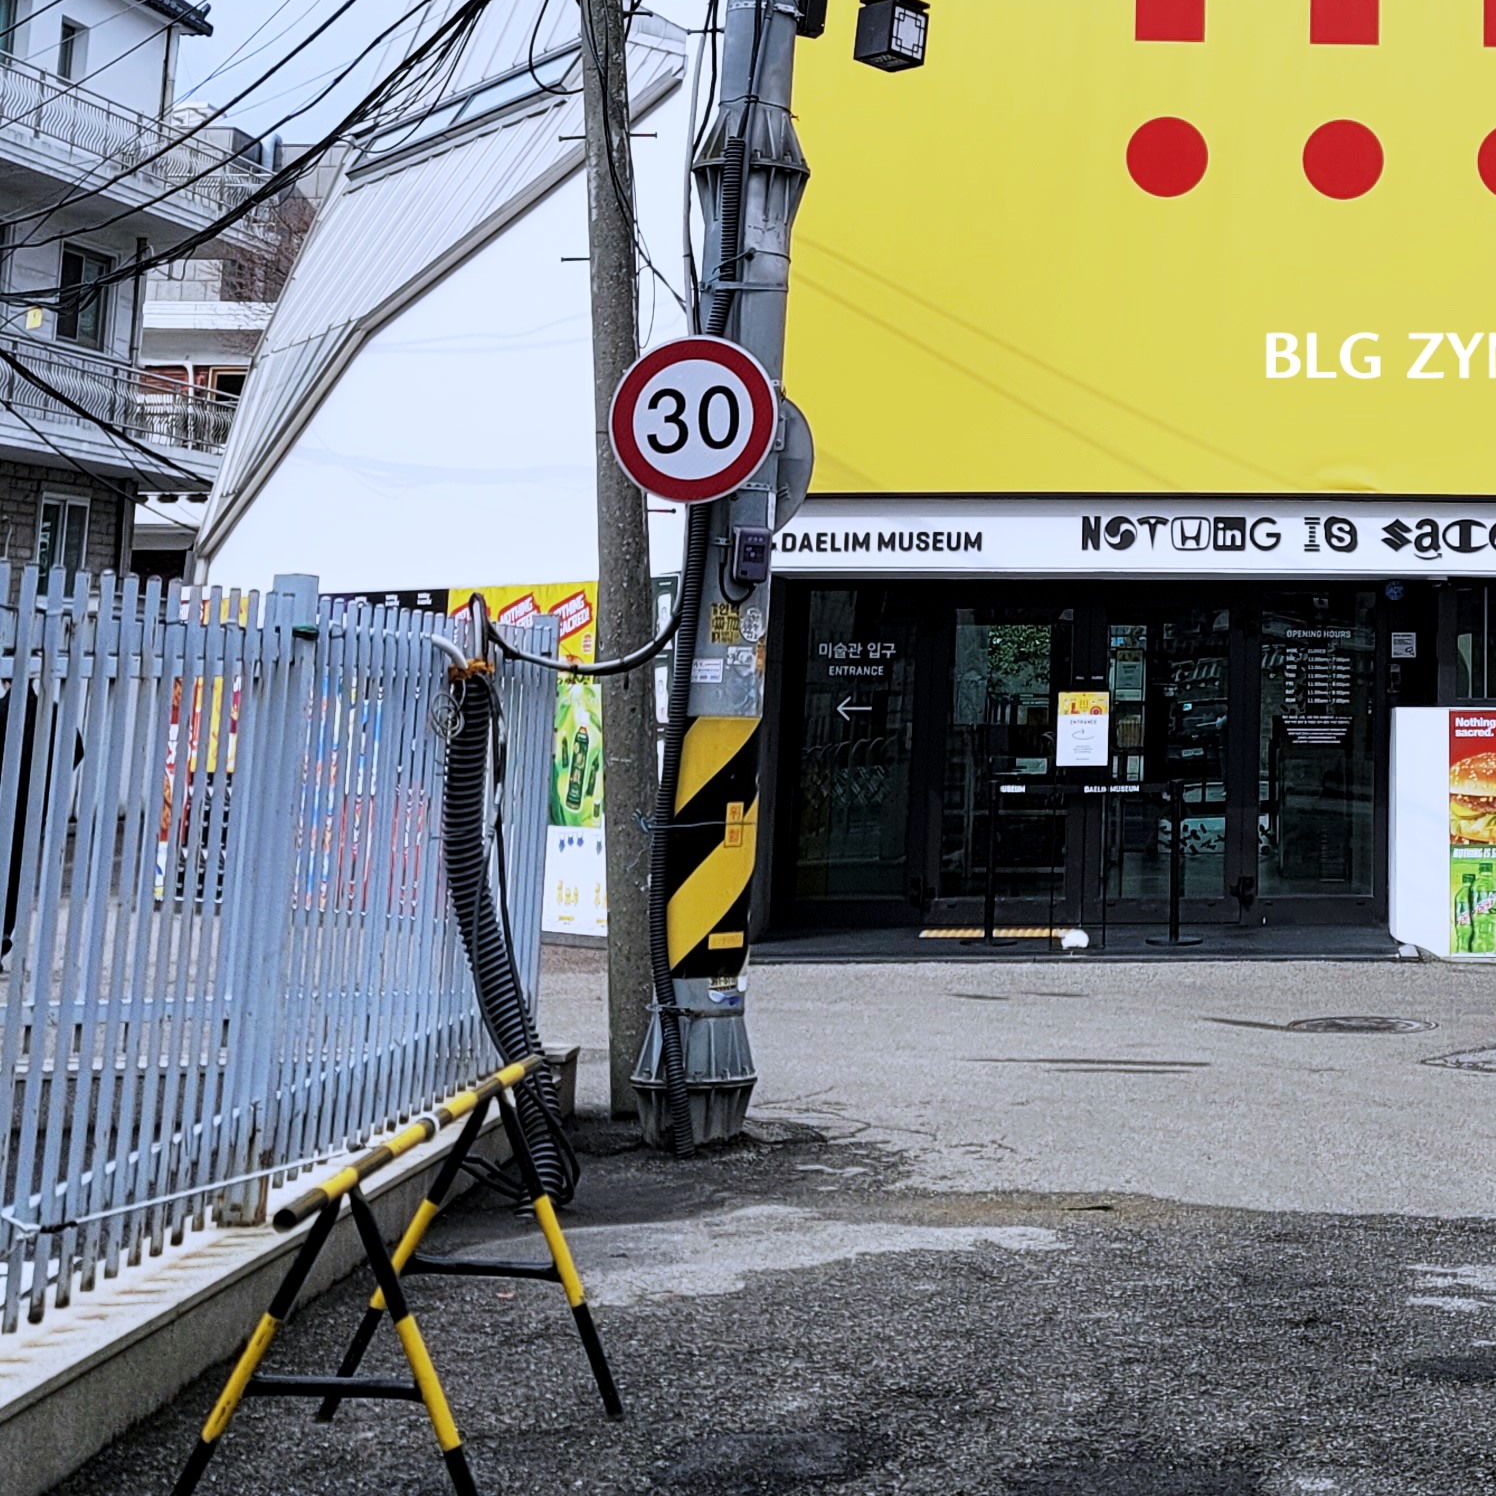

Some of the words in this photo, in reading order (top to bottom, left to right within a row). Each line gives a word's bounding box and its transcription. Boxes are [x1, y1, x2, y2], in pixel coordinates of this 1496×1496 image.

[647, 385, 740, 454] 30
[780, 532, 870, 552] DAELIM
[877, 531, 983, 552] MUSEUM
[1286, 630, 1322, 639] OPENING
[1323, 630, 1352, 639] HOURS
[818, 642, 863, 660] 미술관
[867, 643, 897, 659] 입구
[828, 665, 884, 677] ENTRANCE
[1455, 716, 1496, 729] Nothing
[1455, 727, 1495, 738] sacred.
